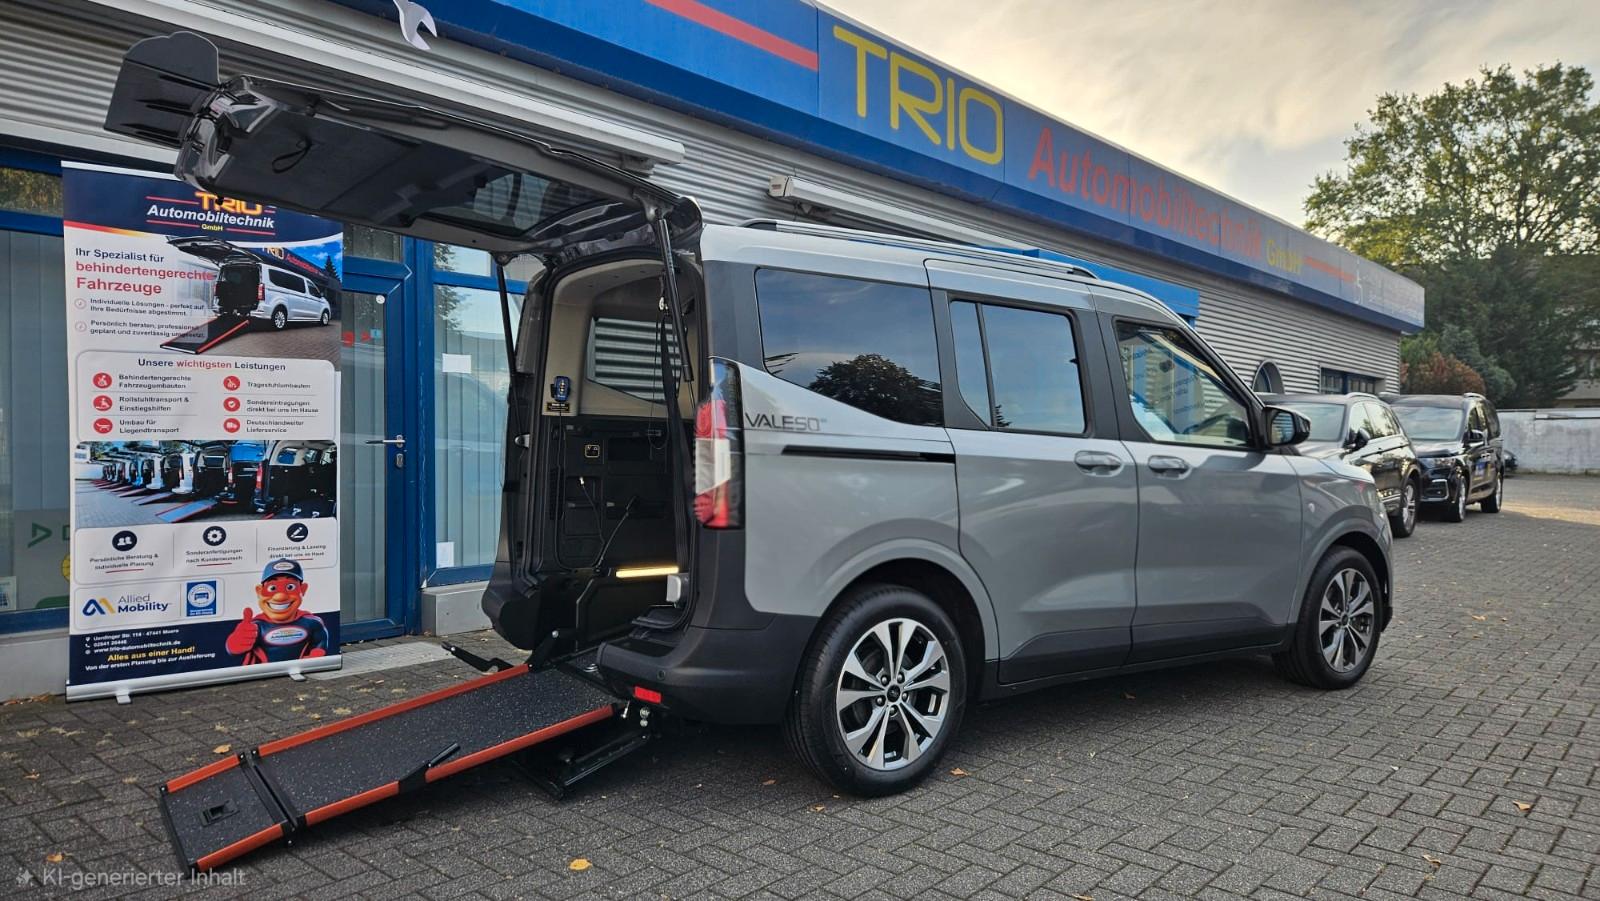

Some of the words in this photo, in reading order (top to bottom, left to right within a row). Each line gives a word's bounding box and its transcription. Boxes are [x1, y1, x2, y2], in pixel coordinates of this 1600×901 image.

[833, 25, 1003, 165] TRIO
[1028, 127, 1262, 260] Automobiltechnik
[147, 204, 274, 228] Automobiltechnik
[201, 223, 223, 232] GmbH
[75, 247, 90, 256] Ihr
[94, 249, 147, 262] Spezialist
[149, 253, 164, 262] für
[76, 261, 214, 281] behindertengerechte
[76, 277, 162, 295] Fahrzeuge
[90, 298, 130, 306] Individuelle
[131, 300, 165, 309] Lösungen
[90, 319, 128, 328] Persönlich
[138, 358, 174, 367] Unsere
[176, 360, 232, 370] wichtigsten
[234, 361, 286, 372] Leistungen
[744, 412, 820, 432] VALESO
[118, 593, 150, 604] Allied
[118, 601, 169, 613] Mobility
[108, 652, 129, 662] Alles
[131, 652, 147, 660] aus
[148, 649, 169, 658] einer
